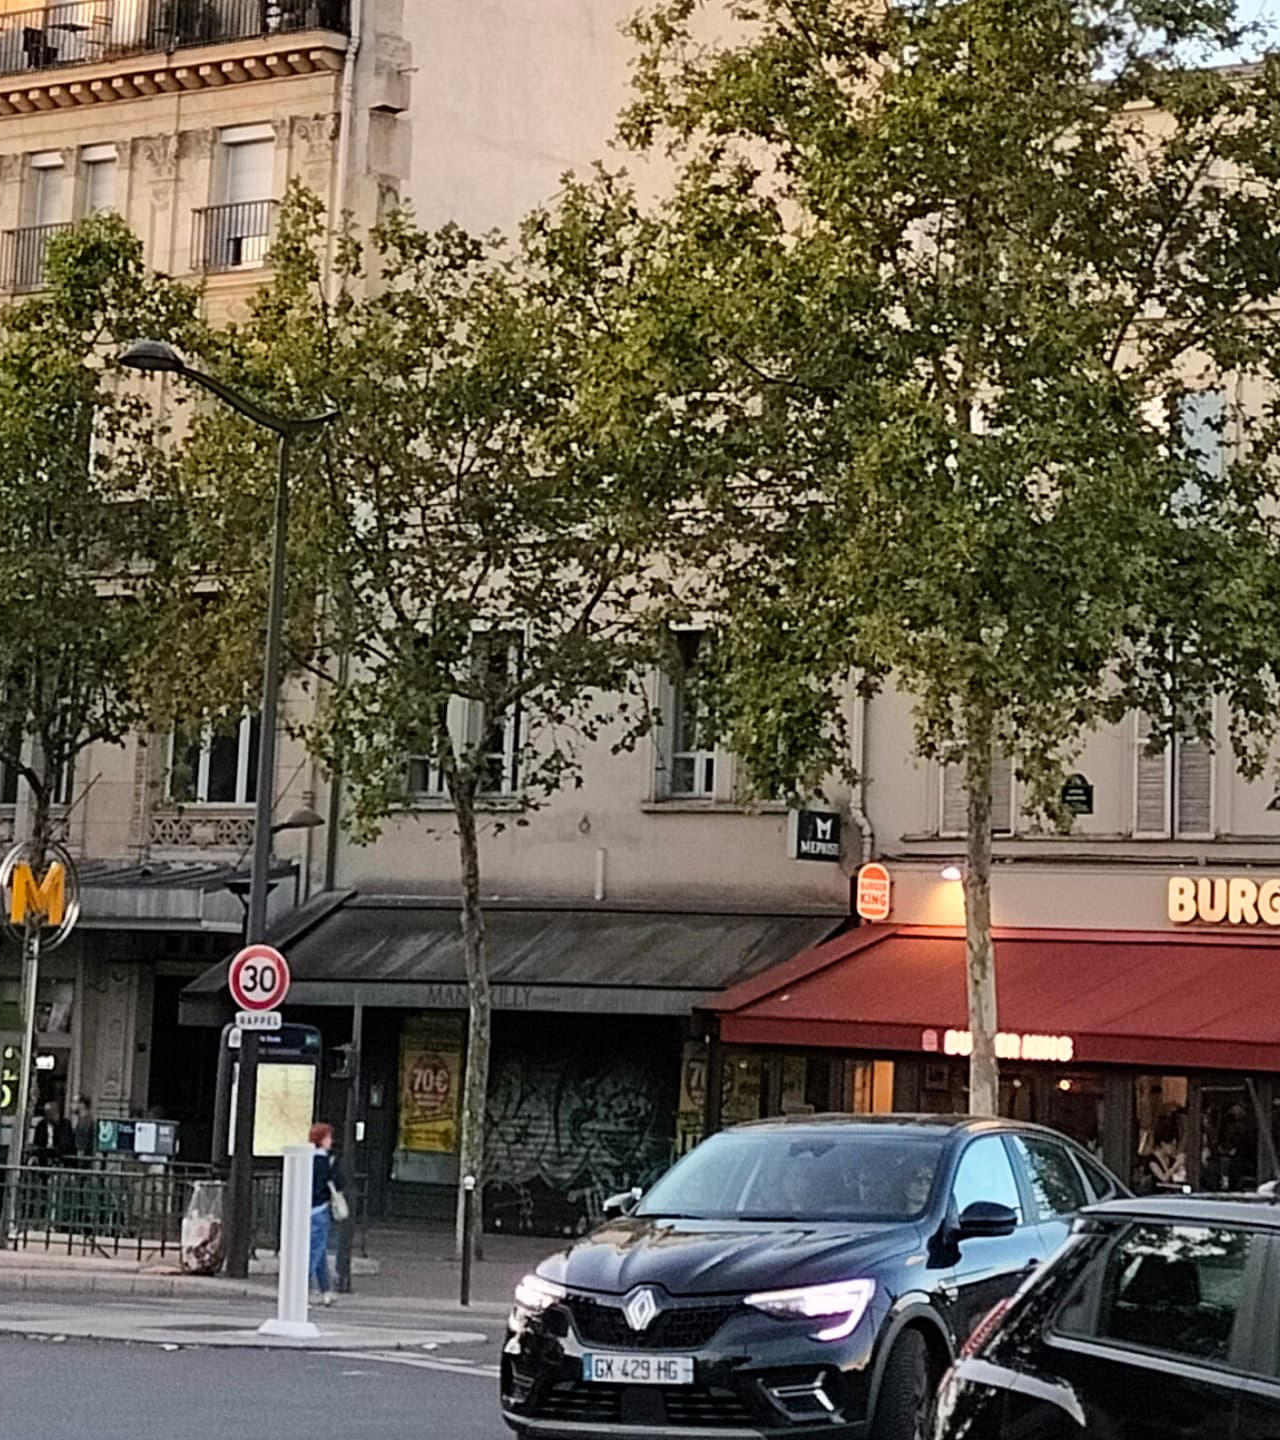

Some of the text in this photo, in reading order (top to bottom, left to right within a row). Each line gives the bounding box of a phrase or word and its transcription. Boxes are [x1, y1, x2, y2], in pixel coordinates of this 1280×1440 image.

[10, 860, 65, 925] M
[860, 892, 887, 907] KING
[243, 965, 276, 992] 30
[239, 1015, 278, 1026] RAPPEL
